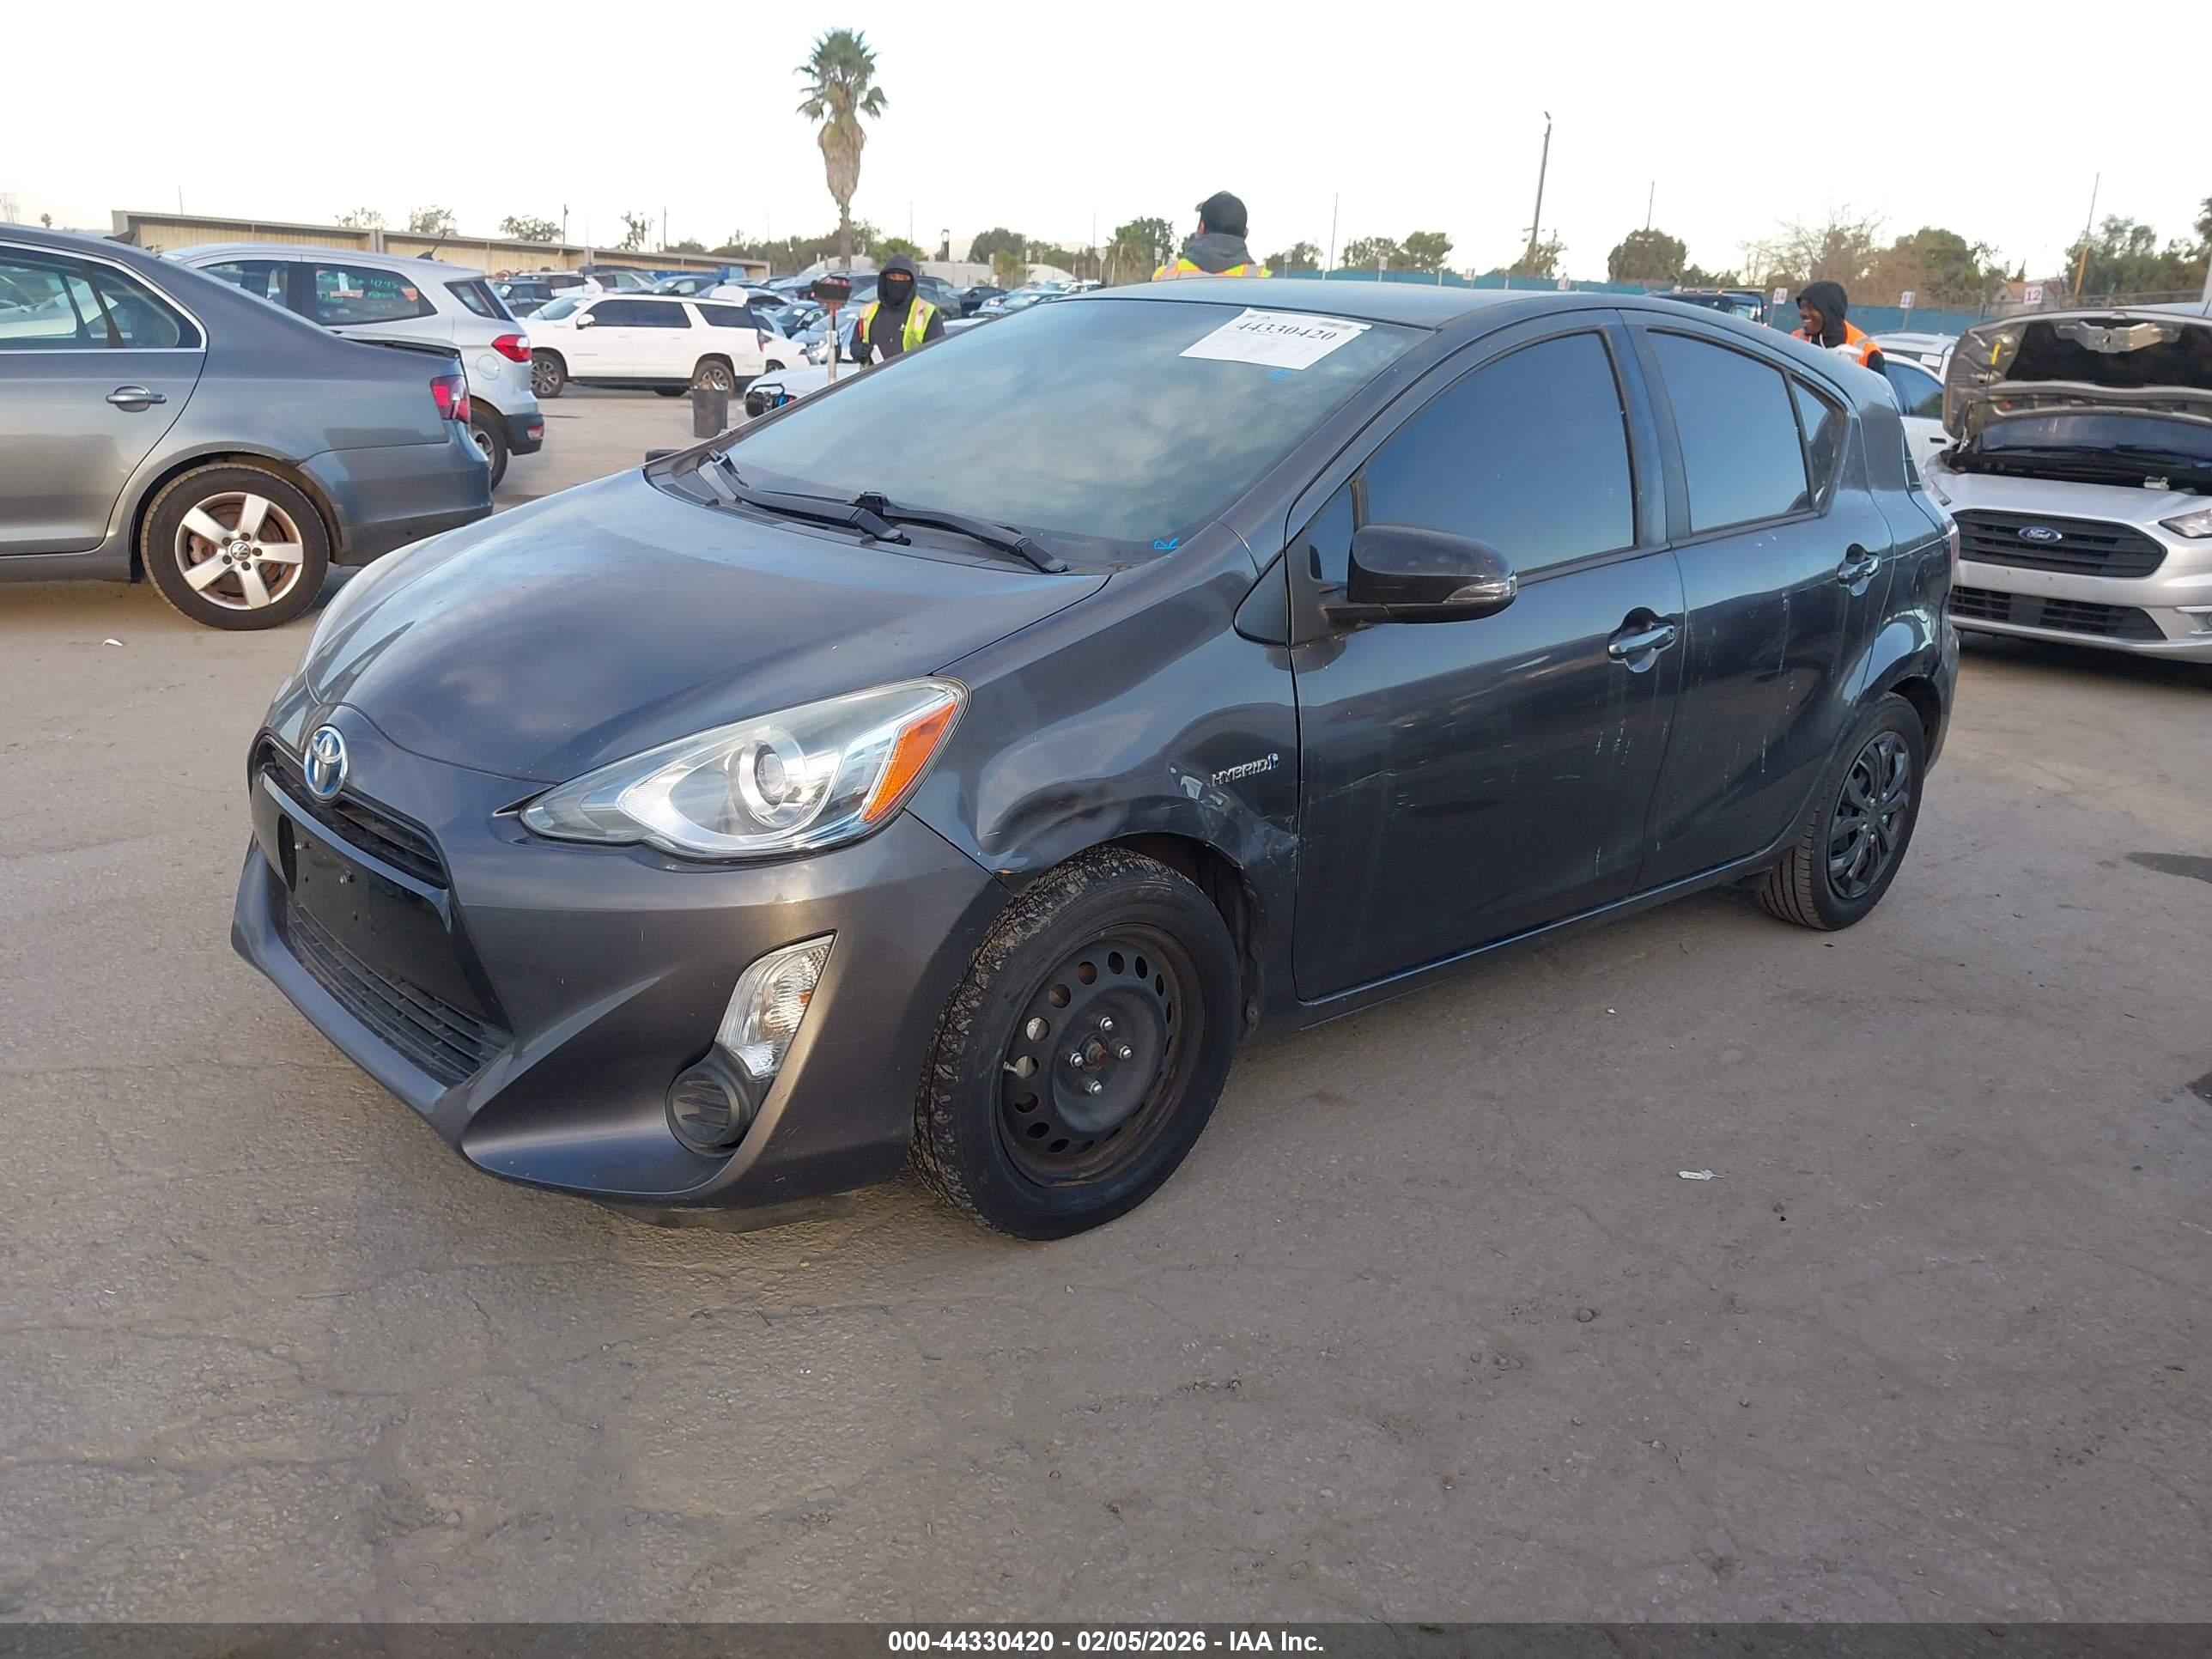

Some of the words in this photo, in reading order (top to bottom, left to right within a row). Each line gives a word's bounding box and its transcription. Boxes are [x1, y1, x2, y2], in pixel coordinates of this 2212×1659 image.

[2026, 289, 2041, 302] 12
[1237, 321, 1337, 341] 44330420
[1211, 758, 1268, 787] HYBRID
